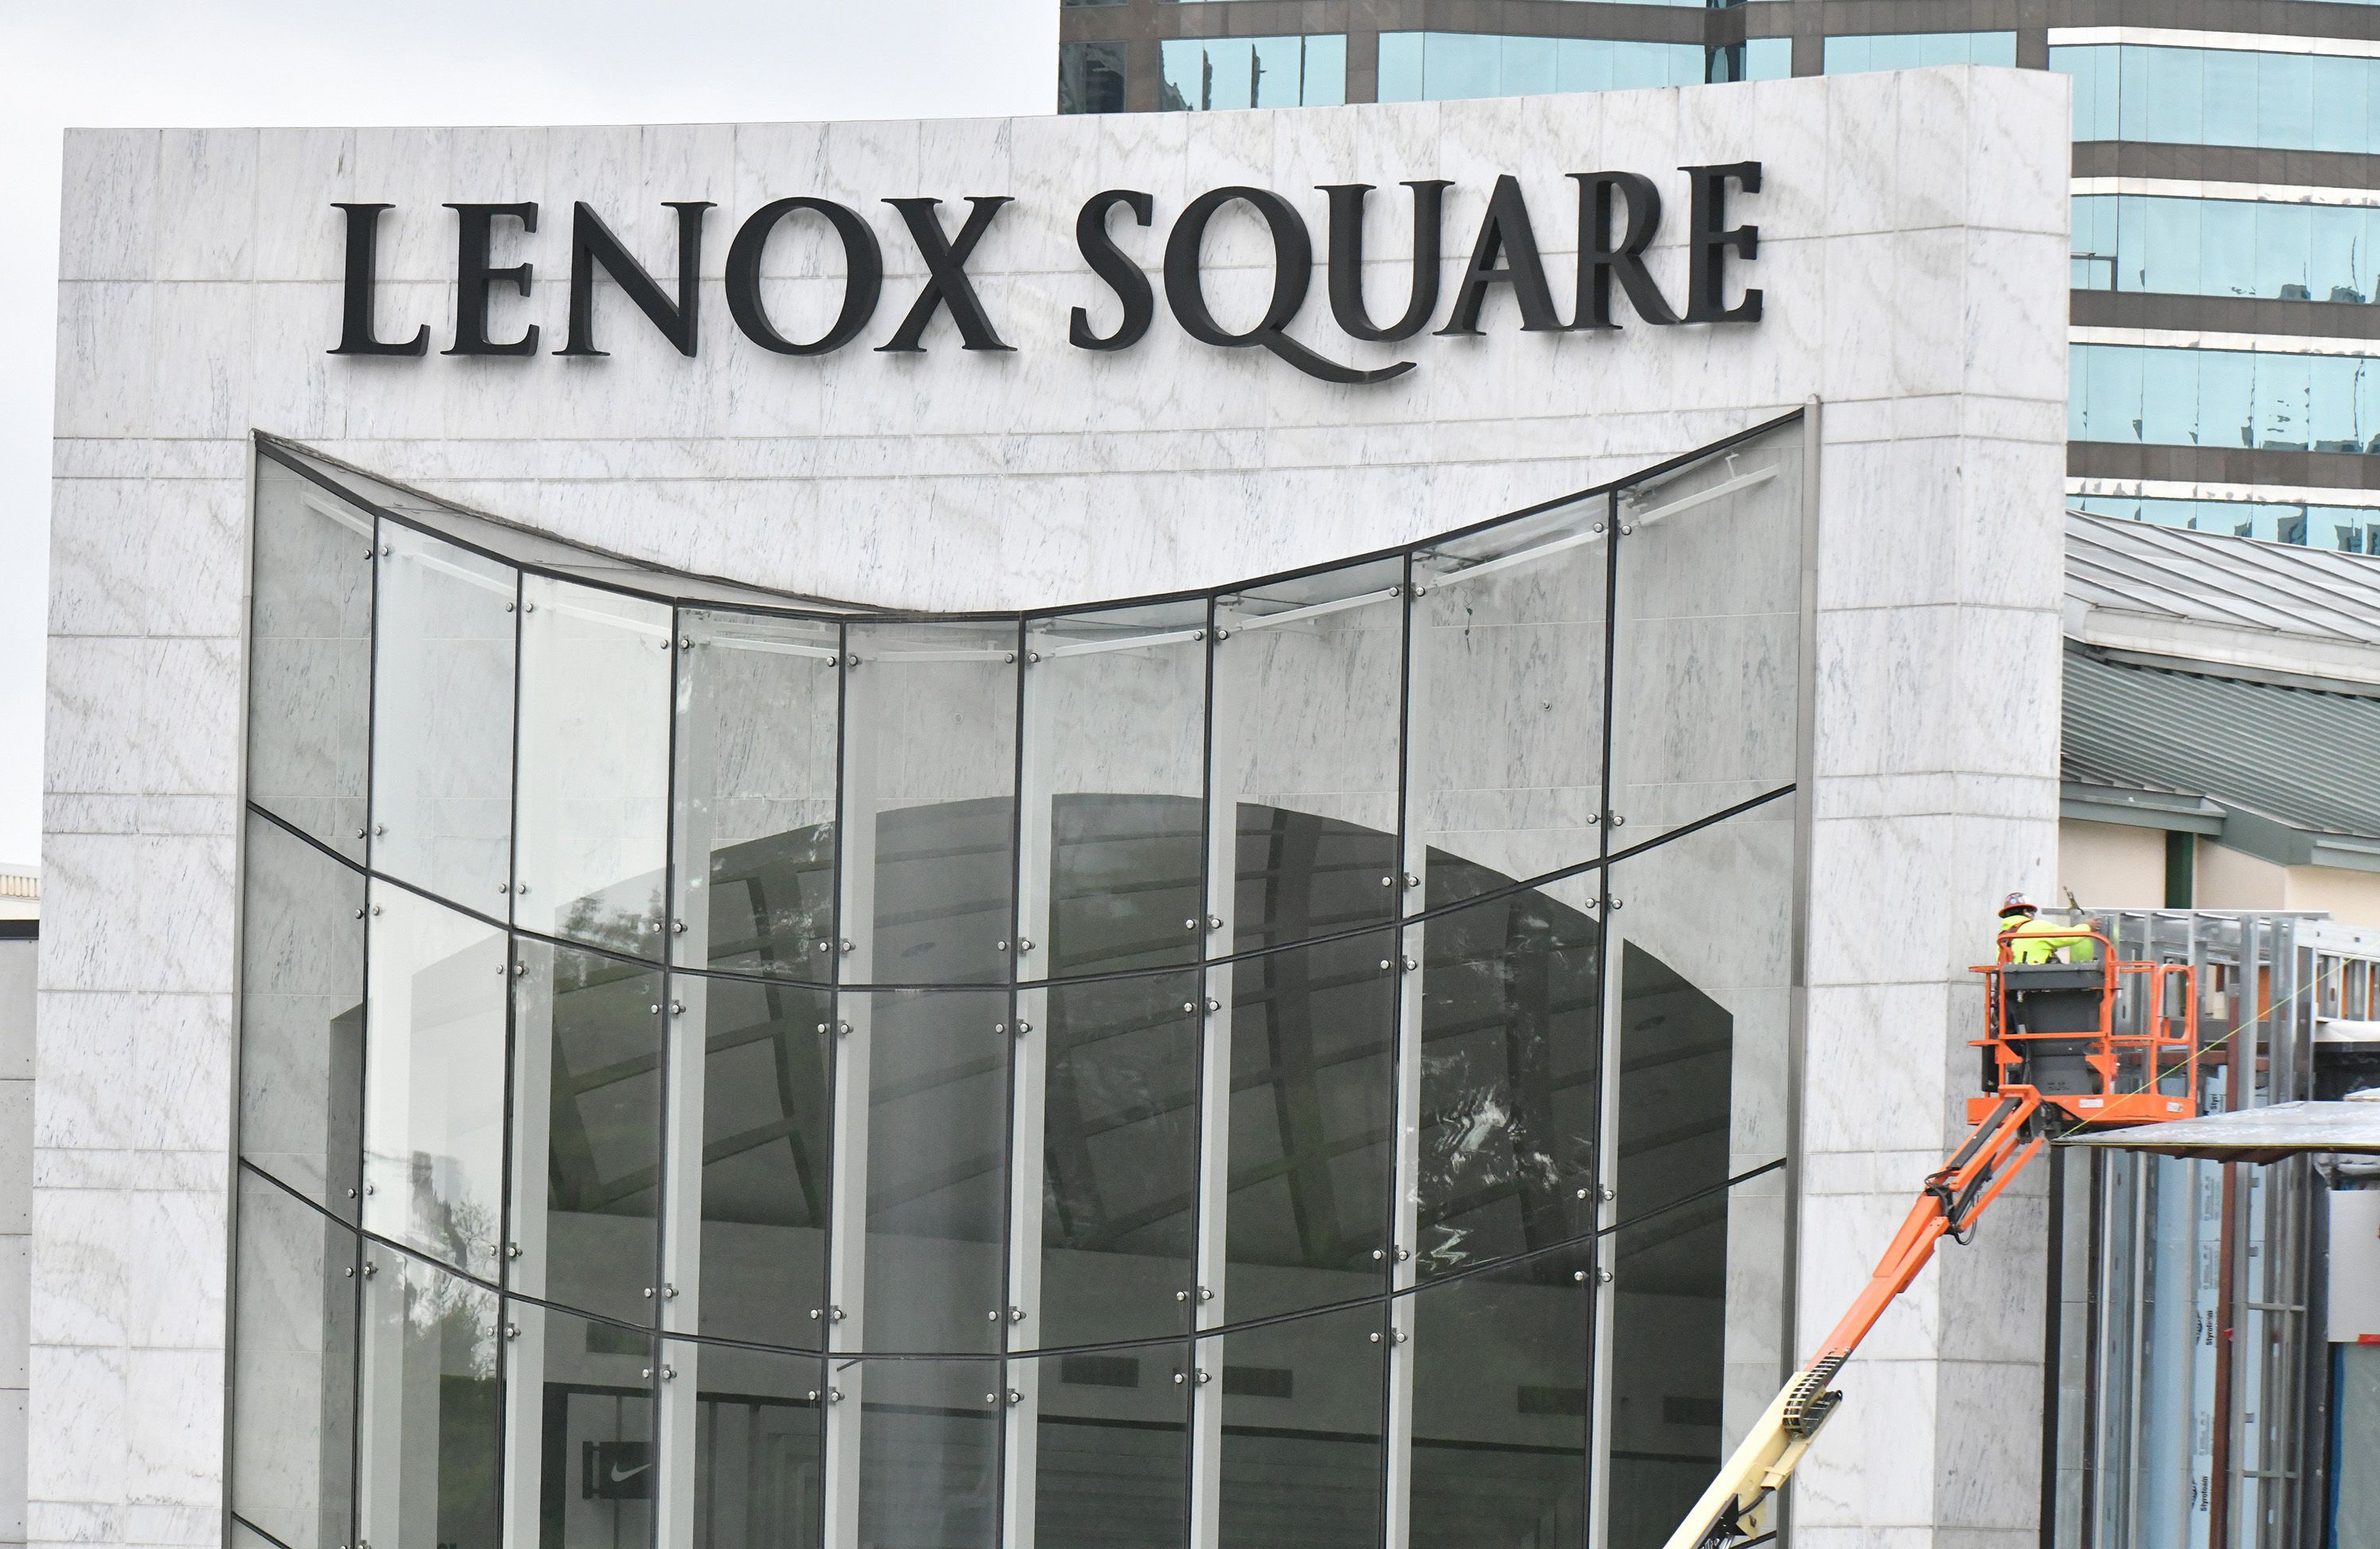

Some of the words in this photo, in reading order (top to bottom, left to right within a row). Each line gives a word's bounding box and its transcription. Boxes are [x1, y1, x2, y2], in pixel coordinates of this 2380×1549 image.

[326, 195, 1017, 357] LENOX
[1069, 160, 1763, 384] SQUARE
[2200, 1476, 2209, 1512] Styrofoam
